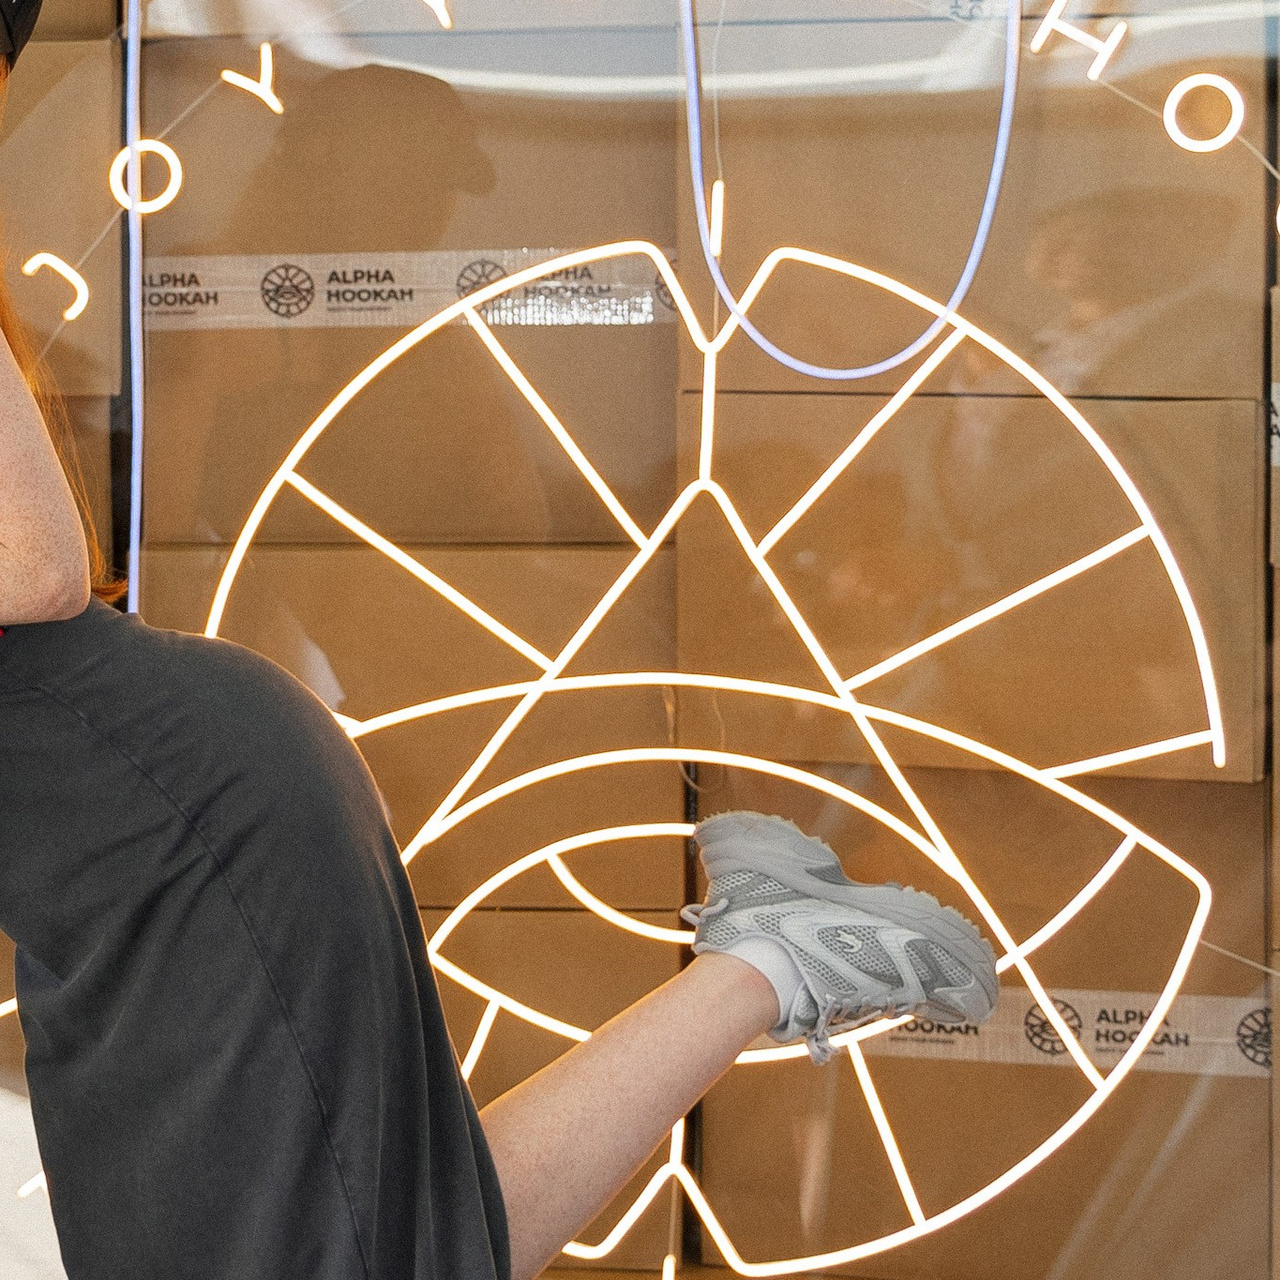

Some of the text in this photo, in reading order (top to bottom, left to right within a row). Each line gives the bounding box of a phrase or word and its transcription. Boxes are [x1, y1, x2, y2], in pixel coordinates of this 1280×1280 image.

[22, 41, 285, 322] JOY
[326, 270, 394, 284] ALPHA
[143, 292, 219, 306] OOKAH
[326, 289, 414, 303] HOOKAH
